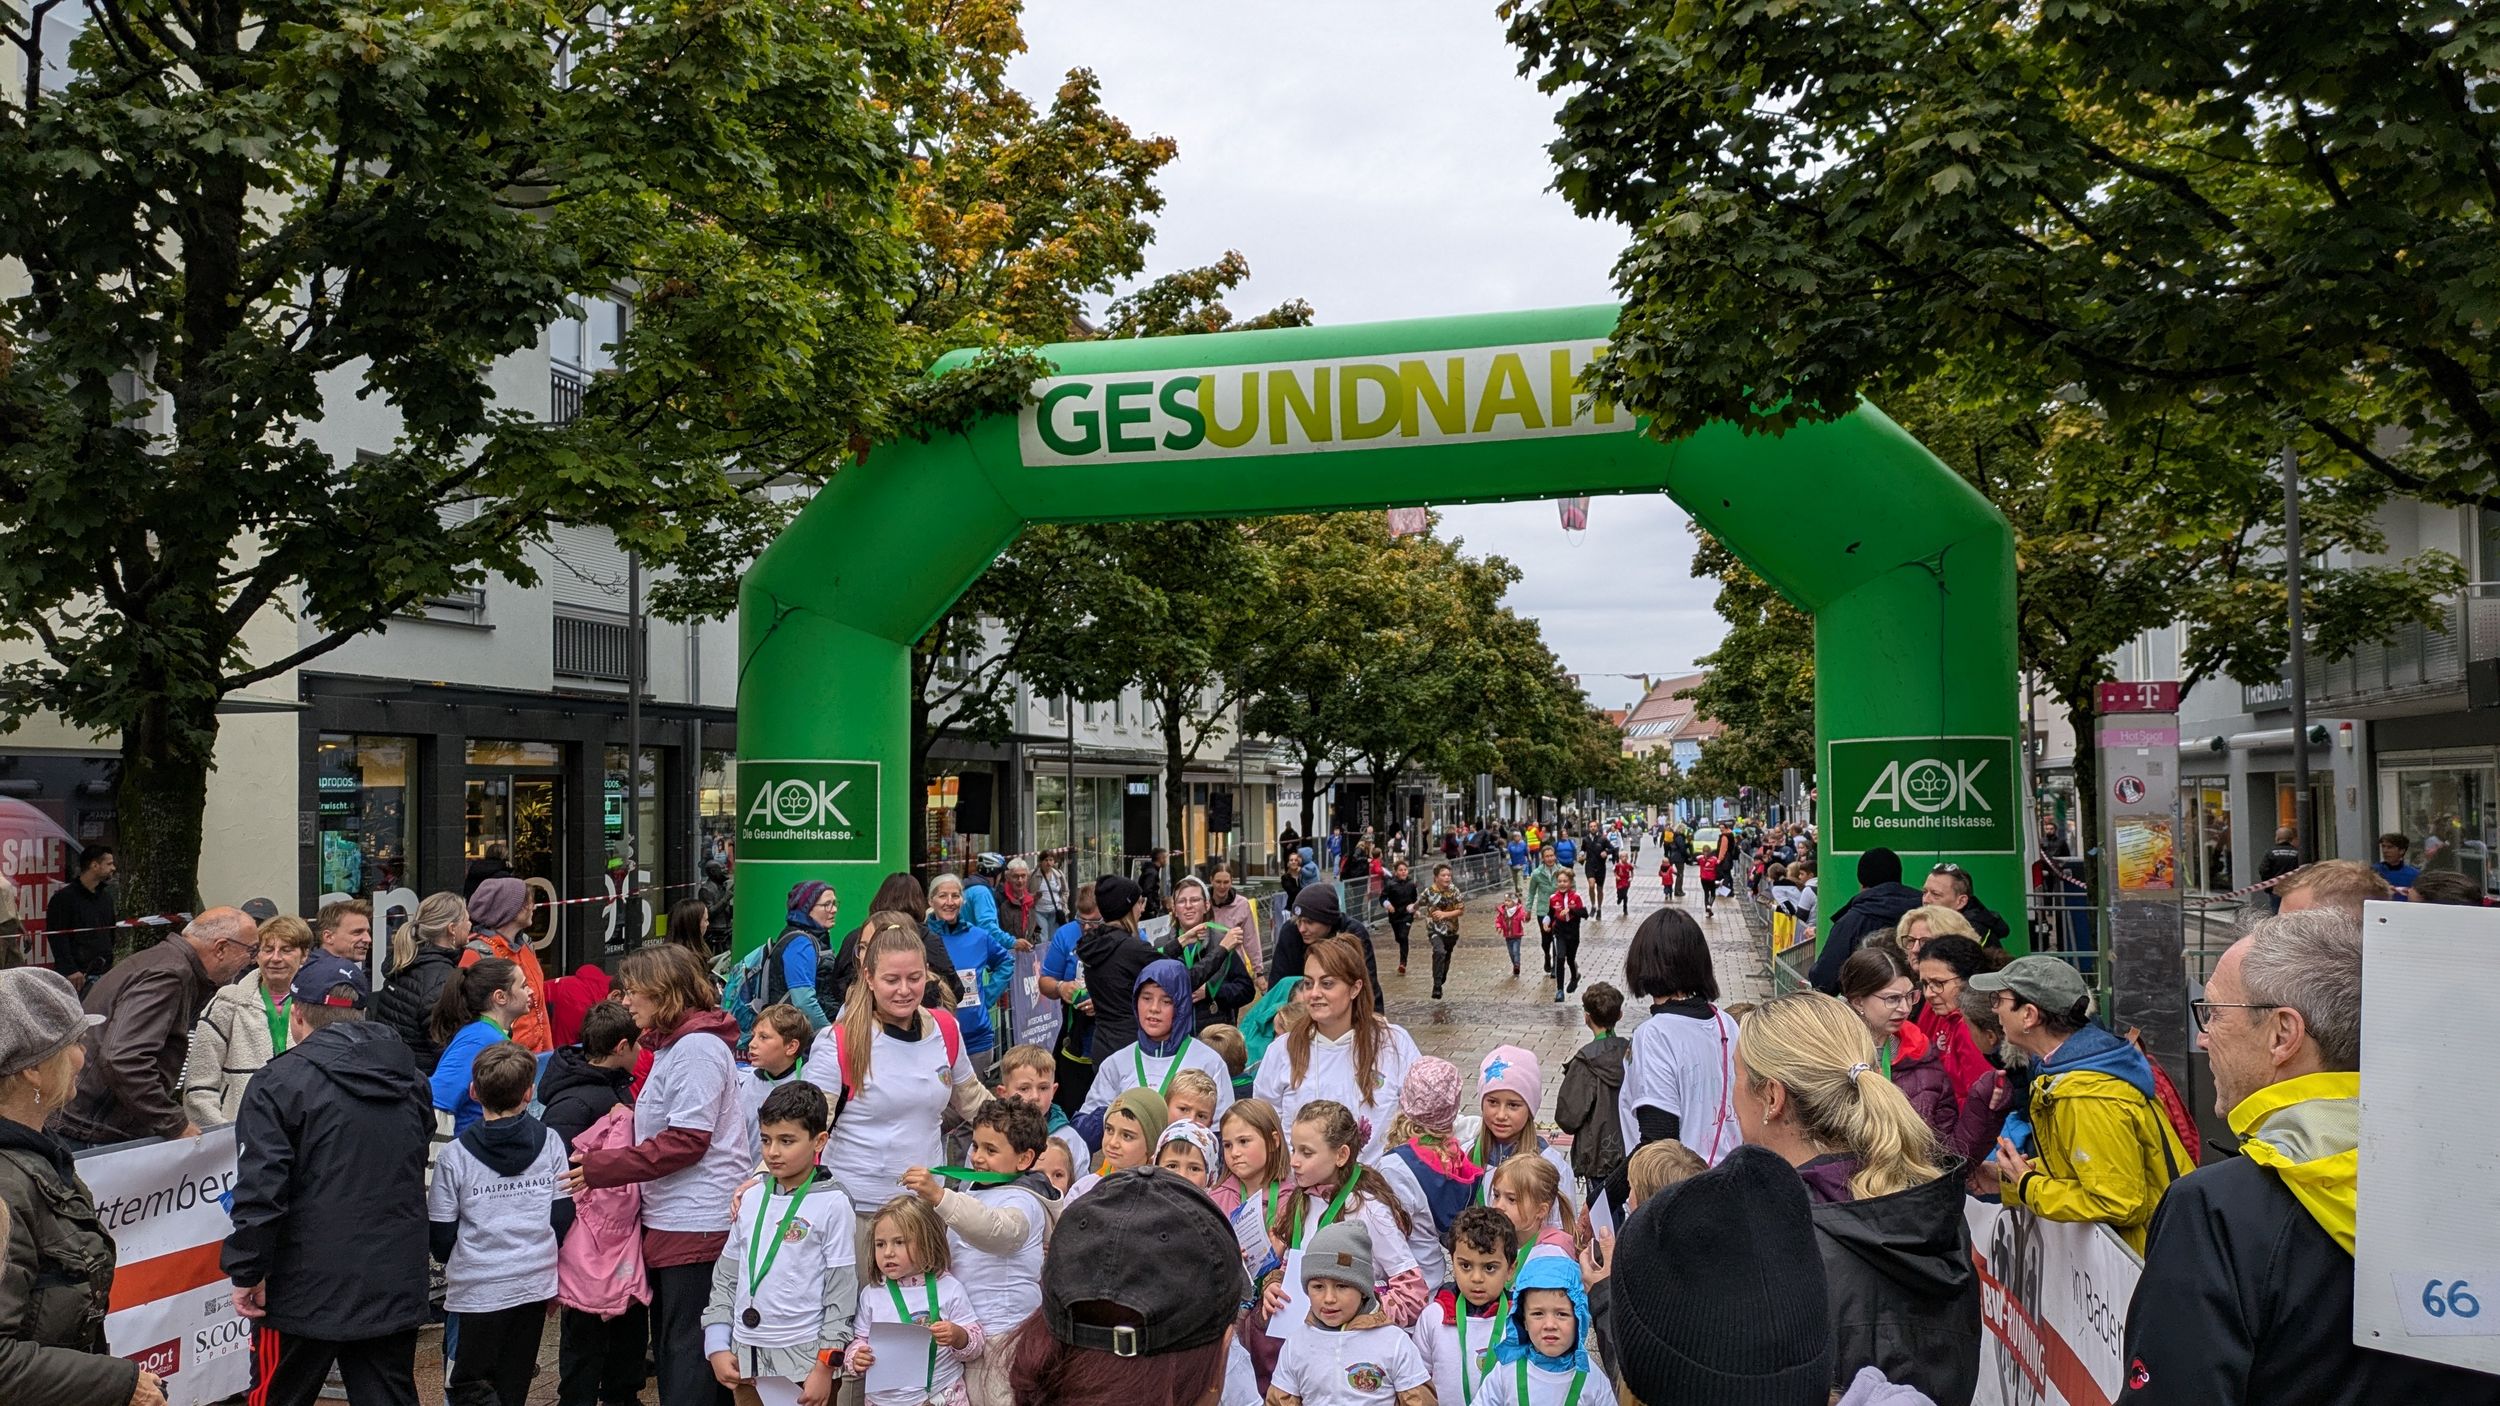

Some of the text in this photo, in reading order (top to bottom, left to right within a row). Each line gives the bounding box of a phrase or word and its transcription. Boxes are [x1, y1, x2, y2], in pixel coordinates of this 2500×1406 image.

[2245, 679, 2293, 705] TRENDSTO
[2120, 730, 2163, 745] HotSpot
[744, 779, 852, 827] AOK
[1855, 758, 1992, 813] AOK
[743, 828, 854, 840] Die Gesundheitskasse.
[1852, 815, 1996, 828] Die Gesundheitskasse.
[2, 837, 61, 877] SALE
[96, 1170, 234, 1231] ttember
[472, 1176, 552, 1196] DIASPORAHAUS
[2071, 1265, 2083, 1310] in
[2422, 1279, 2480, 1318] 66
[195, 1315, 251, 1354] S.COO
[139, 1347, 173, 1372] pOrt
